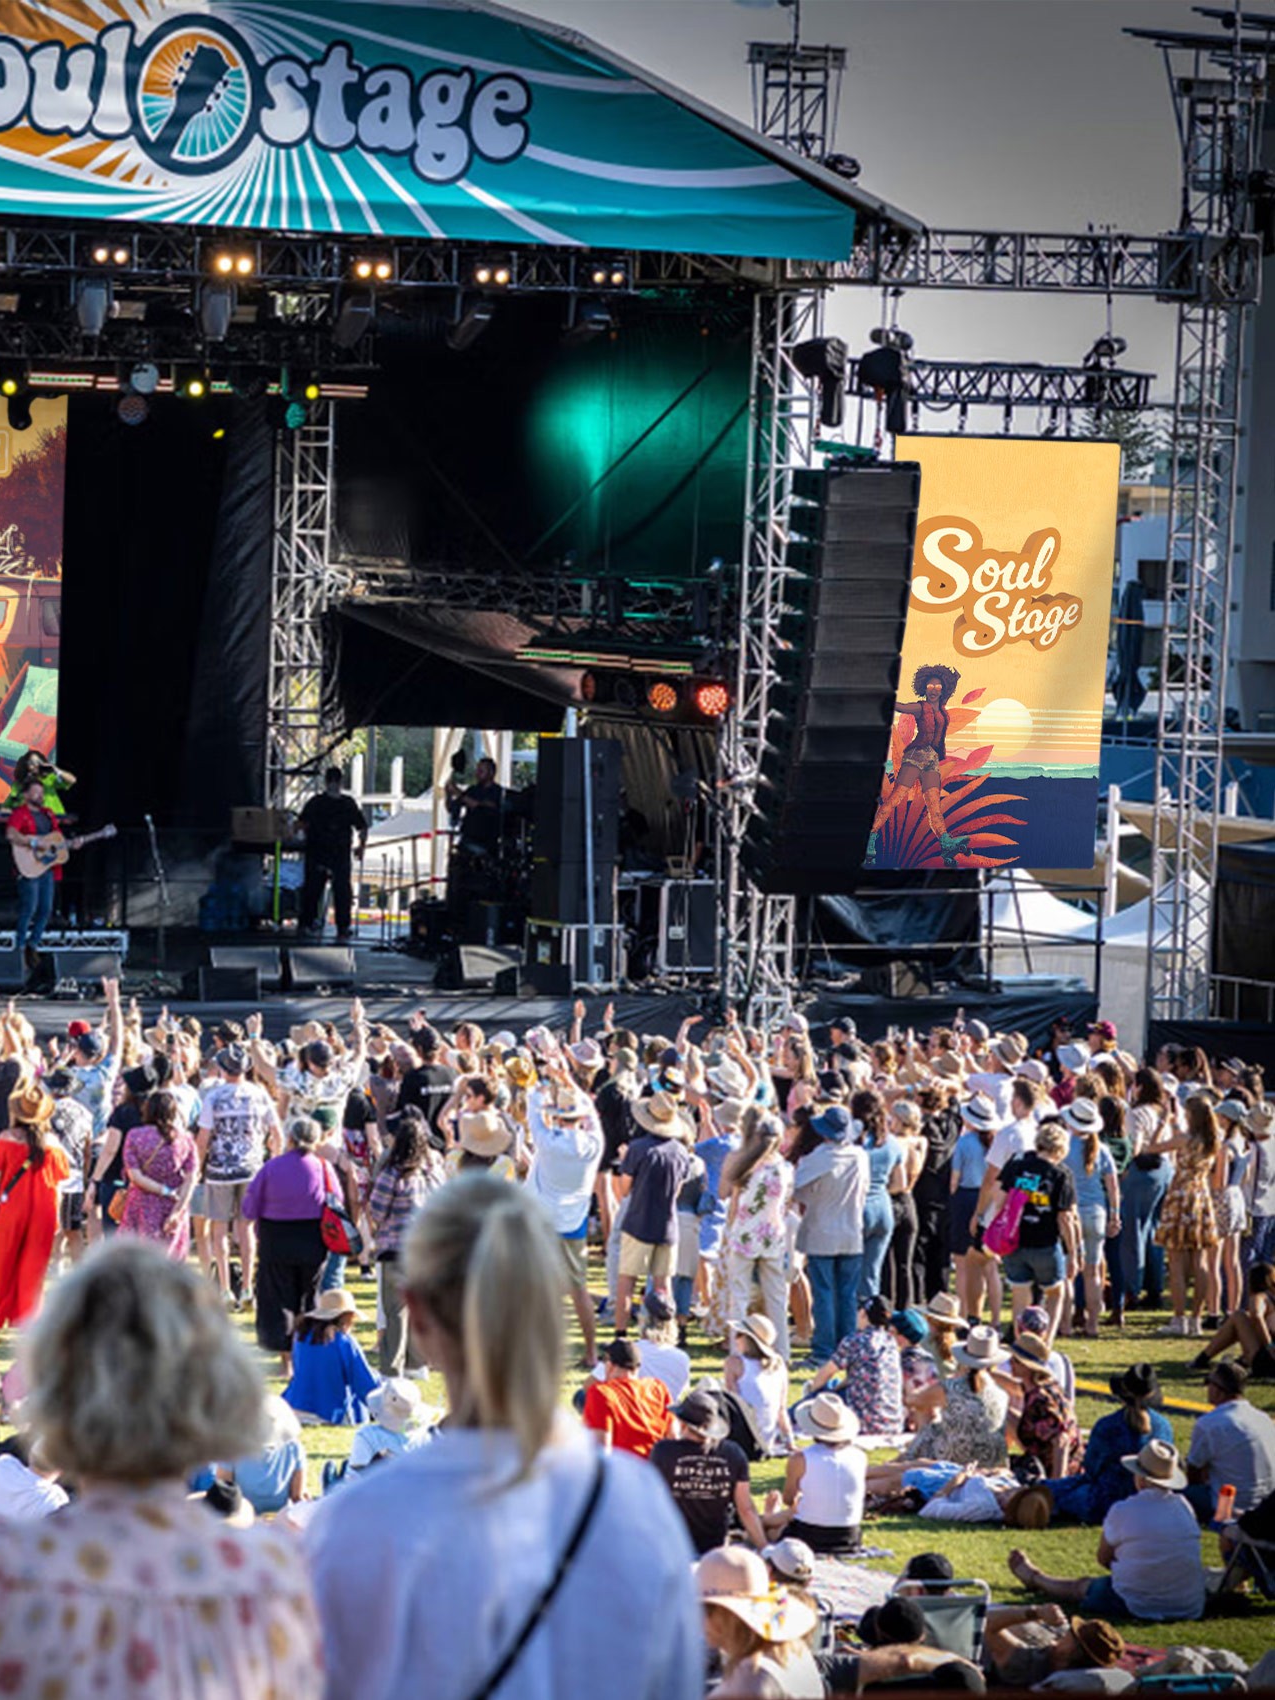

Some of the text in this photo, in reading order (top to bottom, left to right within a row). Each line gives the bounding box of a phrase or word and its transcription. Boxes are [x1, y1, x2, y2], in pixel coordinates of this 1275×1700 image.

[259, 44, 528, 182] stage
[910, 527, 1056, 605] Soul
[962, 590, 1079, 651] Stage
